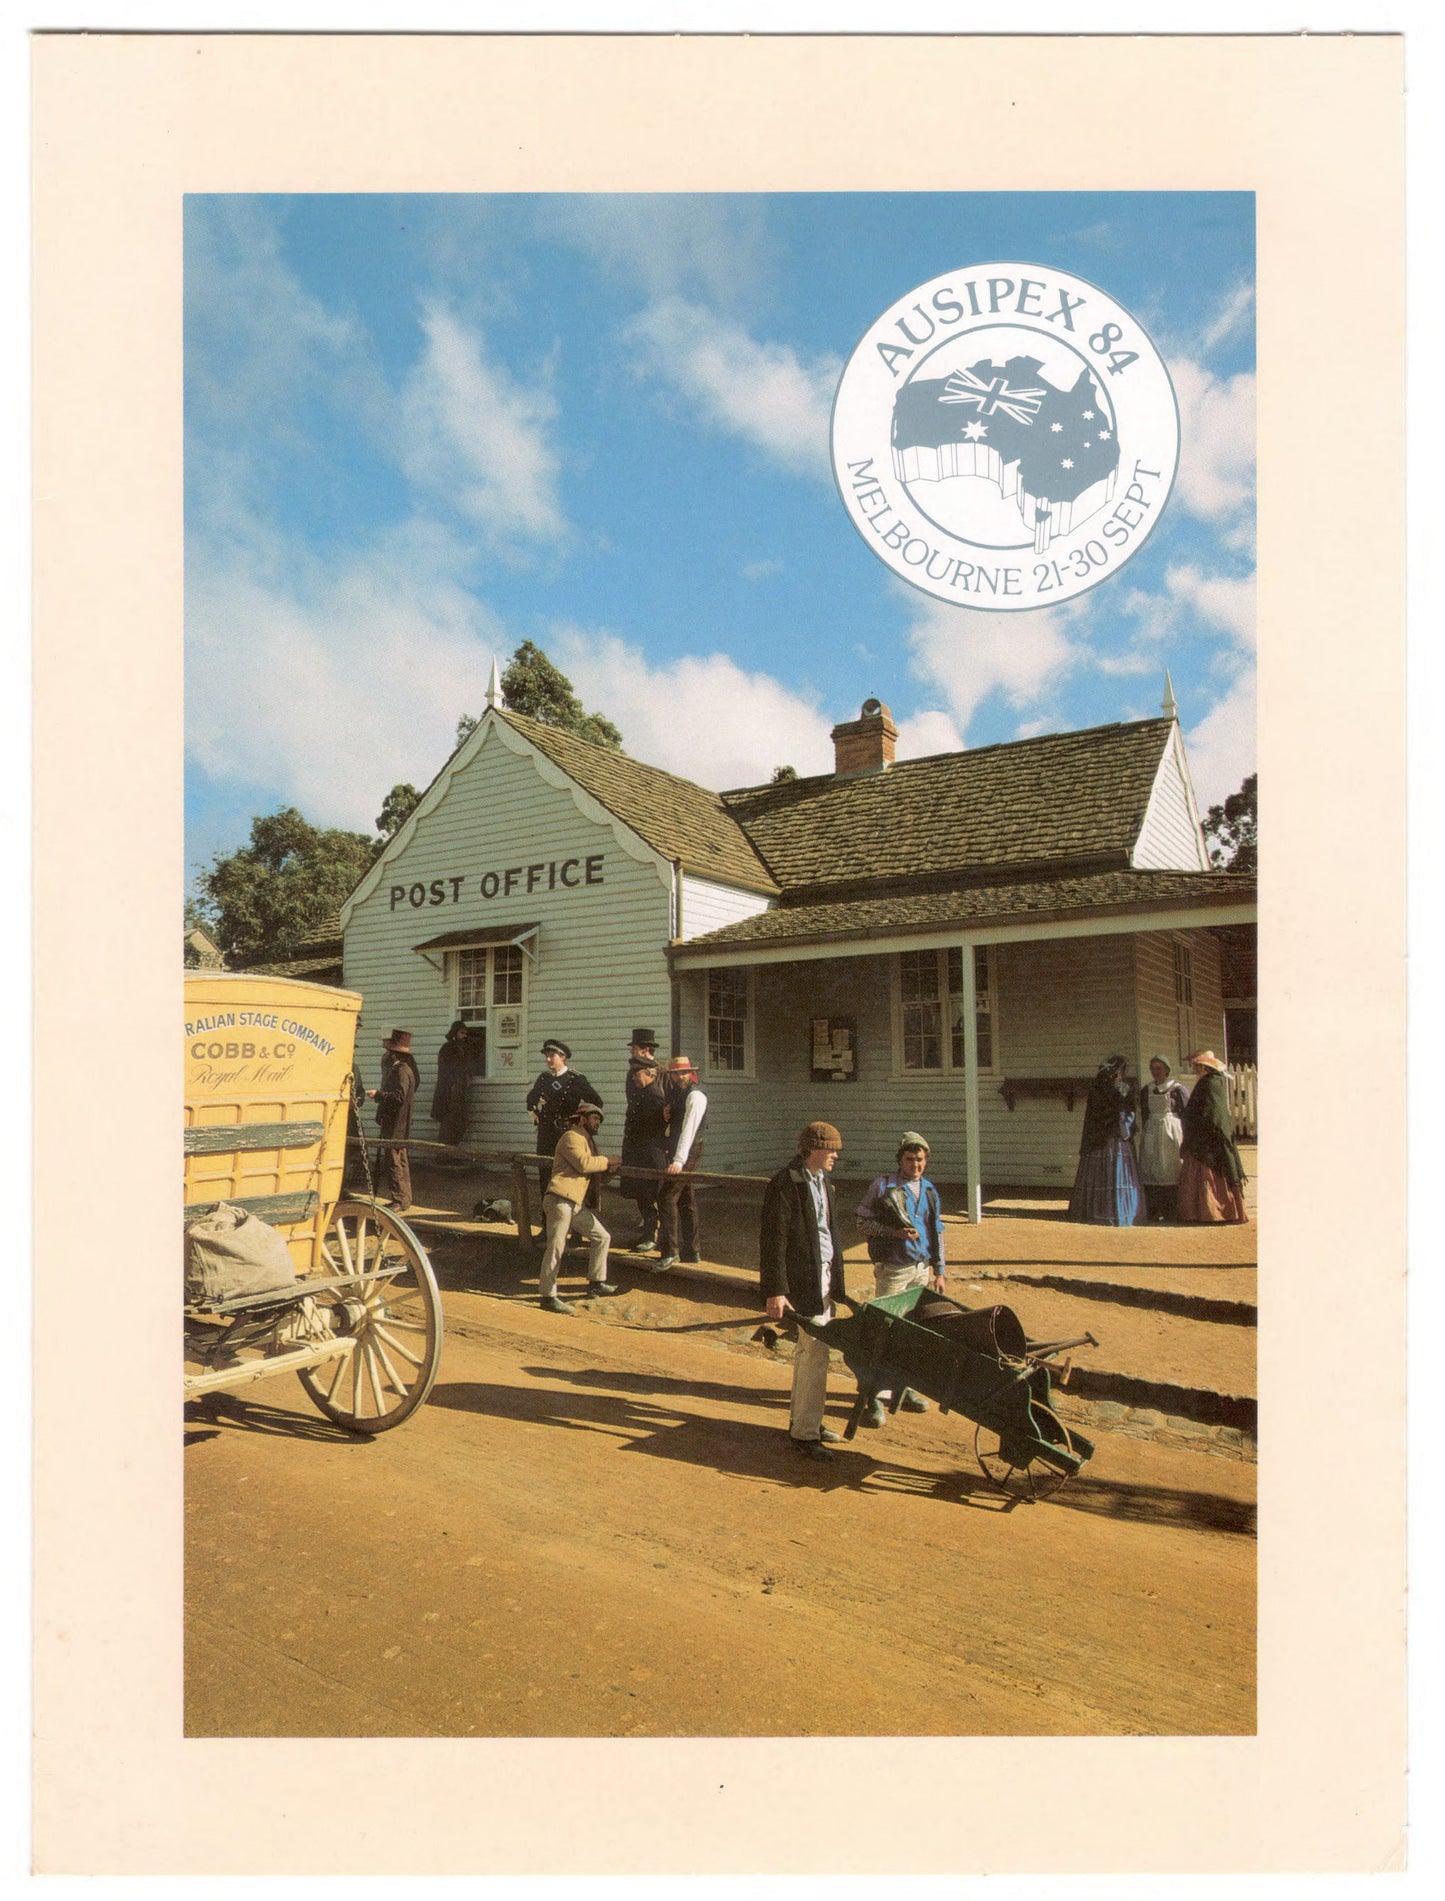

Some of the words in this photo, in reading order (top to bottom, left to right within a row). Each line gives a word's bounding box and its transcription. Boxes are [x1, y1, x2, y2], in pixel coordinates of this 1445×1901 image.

[390, 876, 464, 911] POST
[480, 855, 605, 899] OFFICE
[191, 1042, 256, 1060] COBB
[259, 1047, 271, 1059] &
[239, 1012, 279, 1029] STAGE
[281, 1019, 336, 1056] COMPANY
[190, 1064, 244, 1090] Royal
[248, 1064, 295, 1084] Mail
